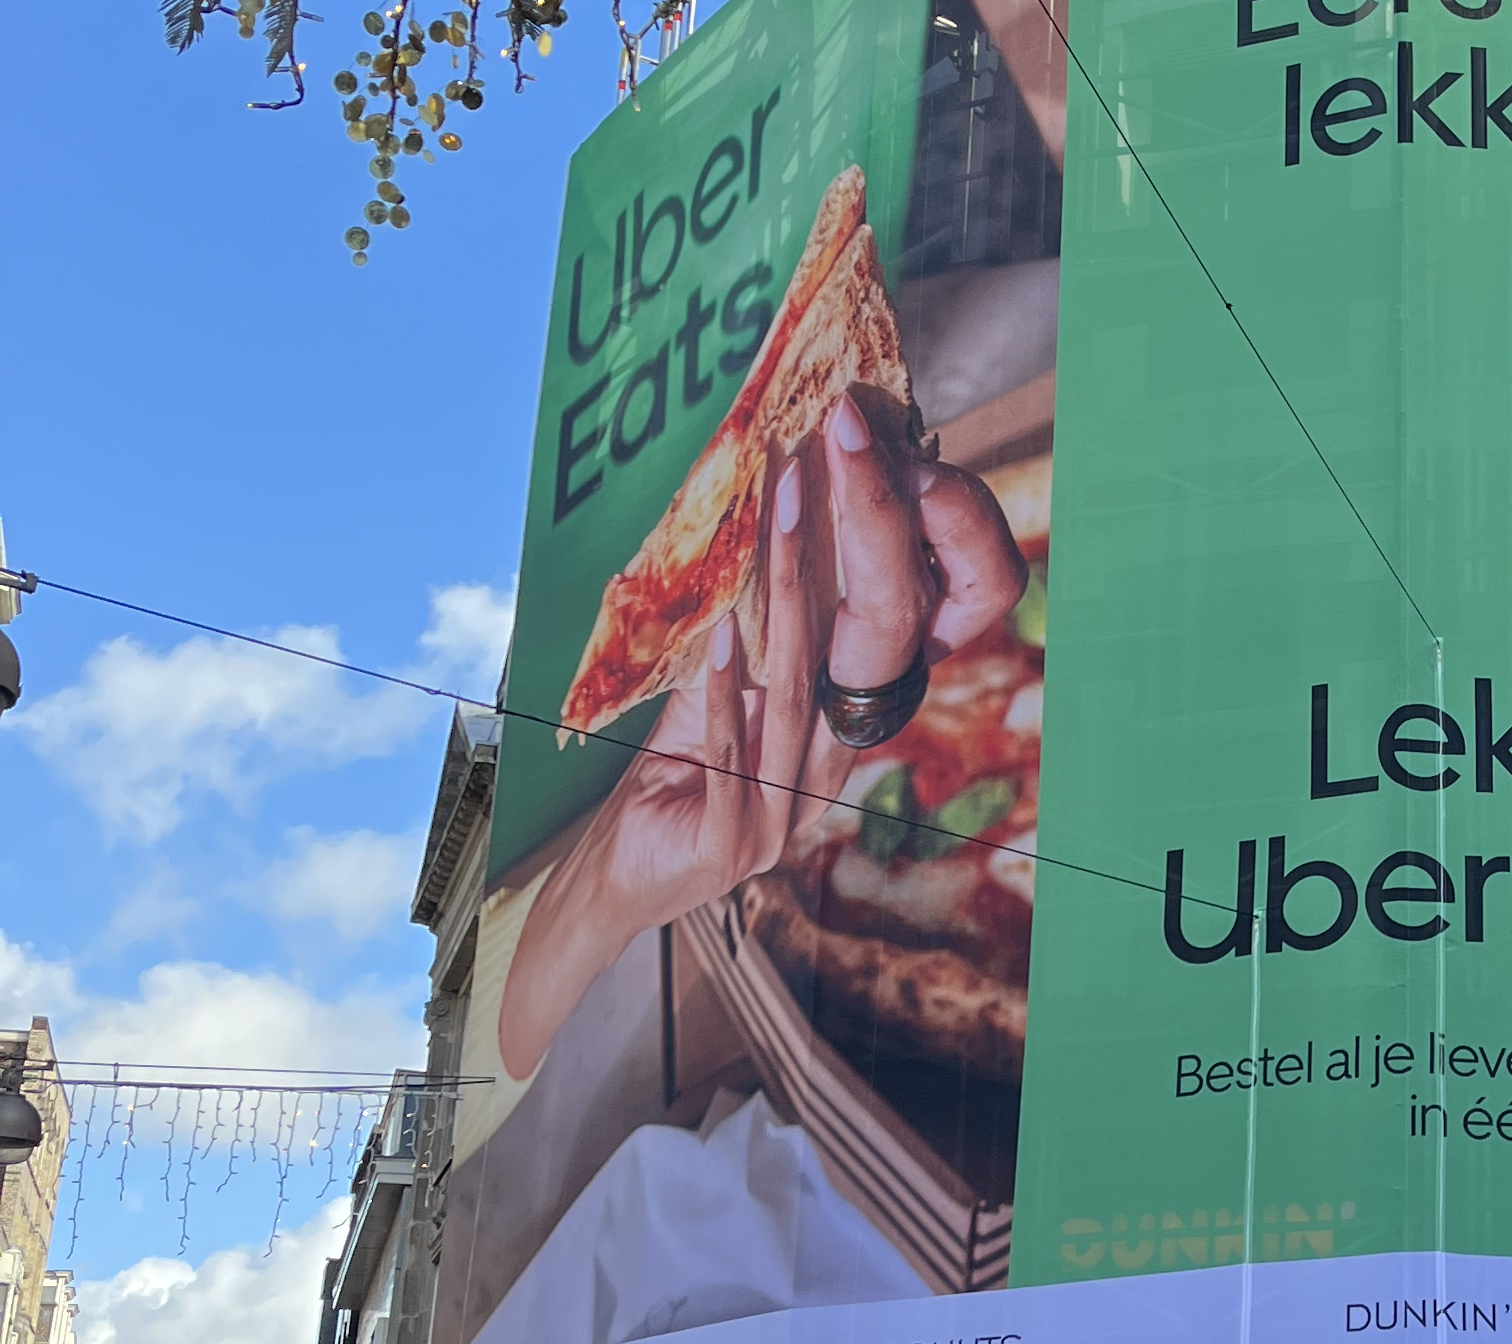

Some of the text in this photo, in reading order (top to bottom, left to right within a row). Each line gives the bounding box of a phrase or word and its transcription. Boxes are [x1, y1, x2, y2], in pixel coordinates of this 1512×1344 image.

[567, 85, 781, 366] Uber
[553, 261, 774, 525] Eats
[1163, 835, 1511, 965] Uber
[1175, 1040, 1314, 1098] Bestel
[1327, 1035, 1360, 1081] al
[1370, 1035, 1414, 1089] je
[1409, 1094, 1449, 1138] in
[1344, 1297, 1512, 1334] DUNKIN'
